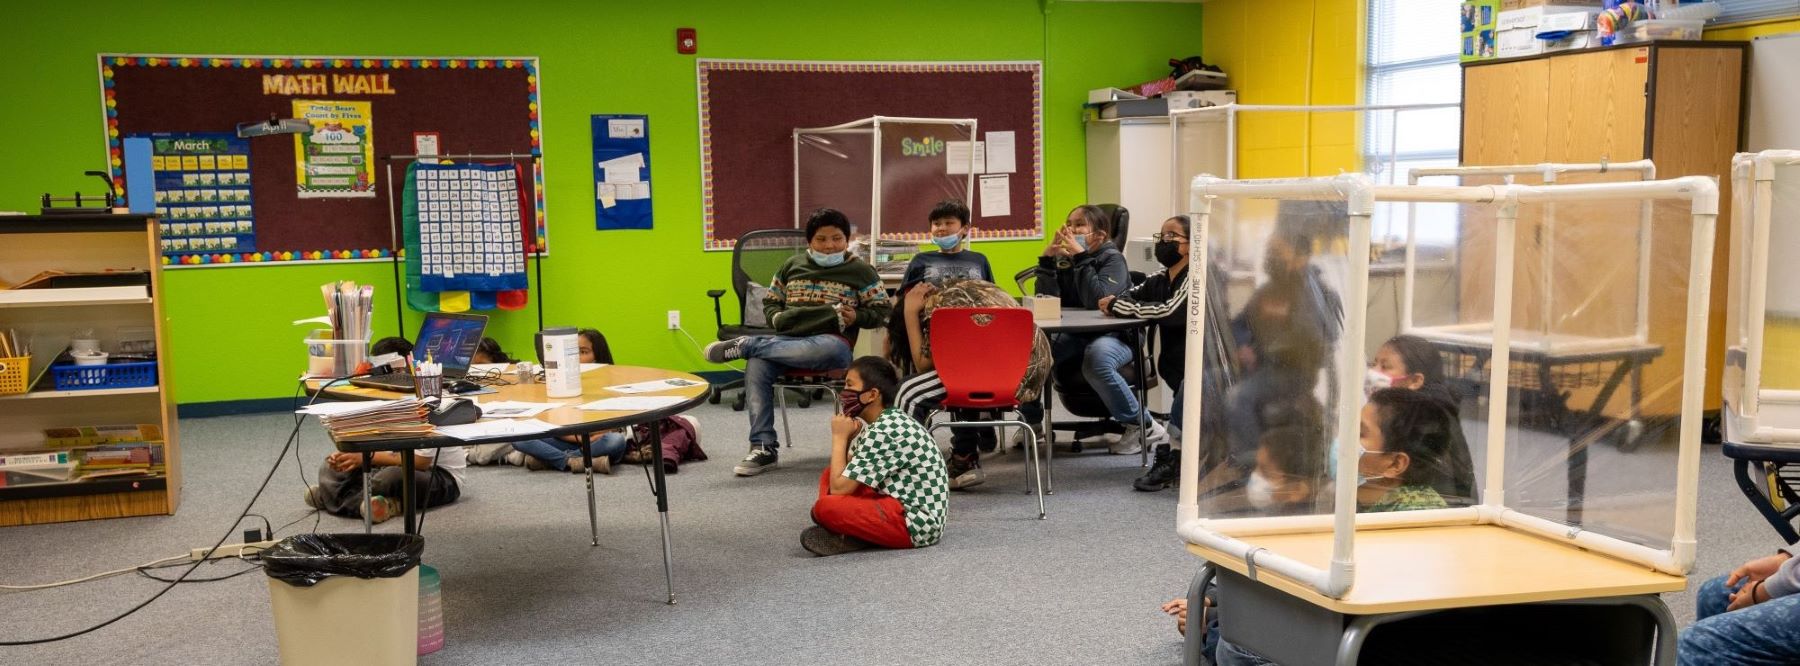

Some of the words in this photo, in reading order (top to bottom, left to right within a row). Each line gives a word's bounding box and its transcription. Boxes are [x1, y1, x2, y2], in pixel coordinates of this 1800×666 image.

[262, 74, 328, 95] MATH
[333, 74, 396, 95] WALL
[262, 119, 287, 133] April
[325, 132, 343, 141] 100
[174, 140, 210, 150] March
[901, 137, 944, 156] Smile
[1194, 234, 1202, 245] 40
[1193, 246, 1202, 262] SCH
